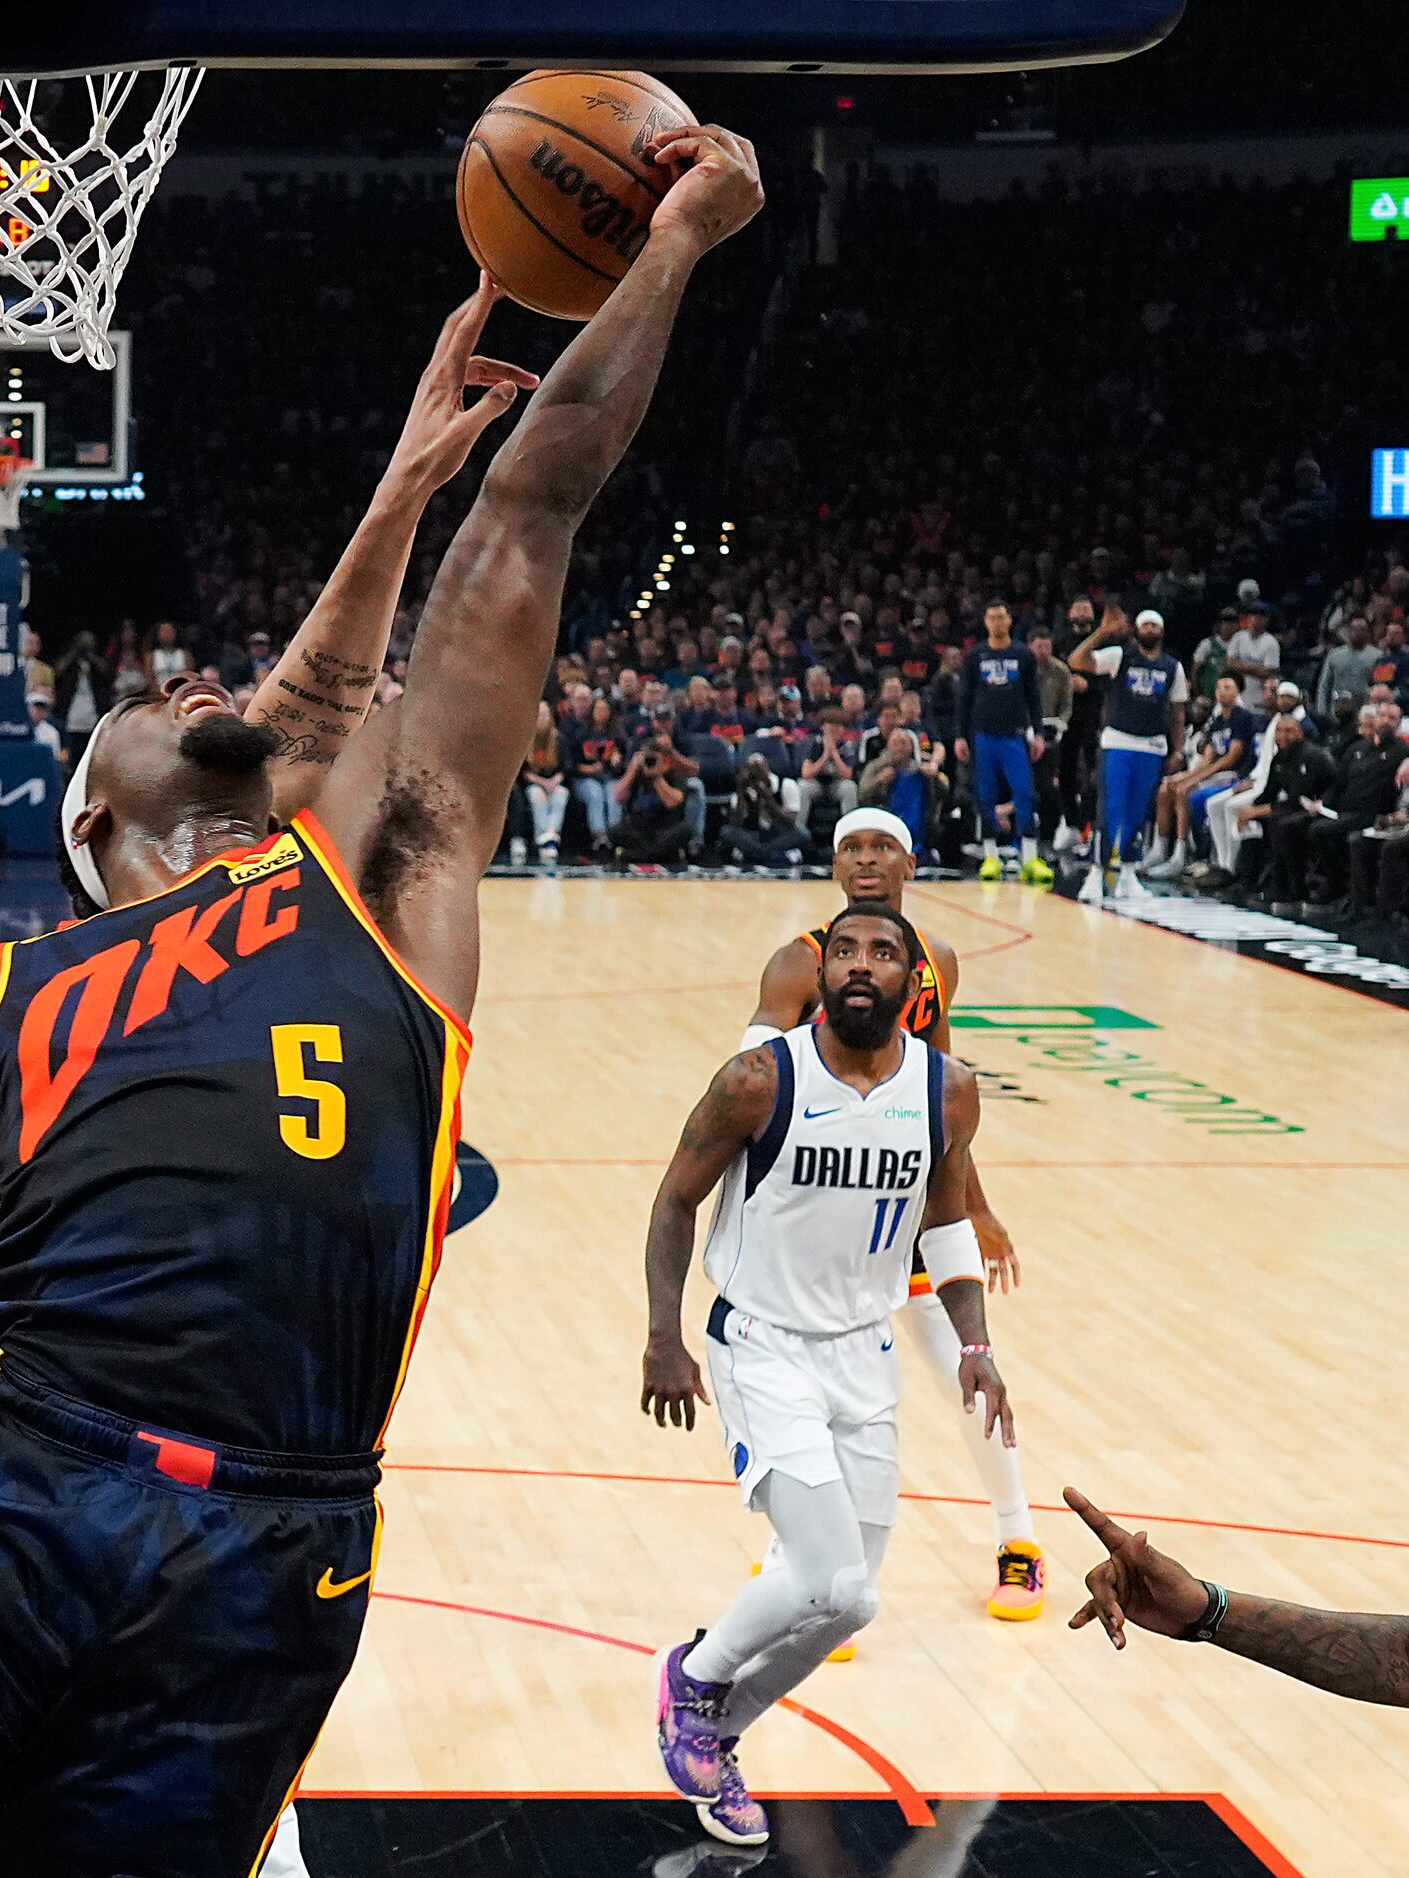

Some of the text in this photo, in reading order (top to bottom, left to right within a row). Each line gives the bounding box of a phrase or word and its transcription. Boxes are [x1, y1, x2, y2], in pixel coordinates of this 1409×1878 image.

[234, 850, 298, 881] Love's
[18, 868, 302, 1164] OKC
[271, 1023, 347, 1161] 5
[884, 1106, 922, 1121] chime
[791, 1145, 922, 1190] DALLAS
[868, 1197, 910, 1255] 11
